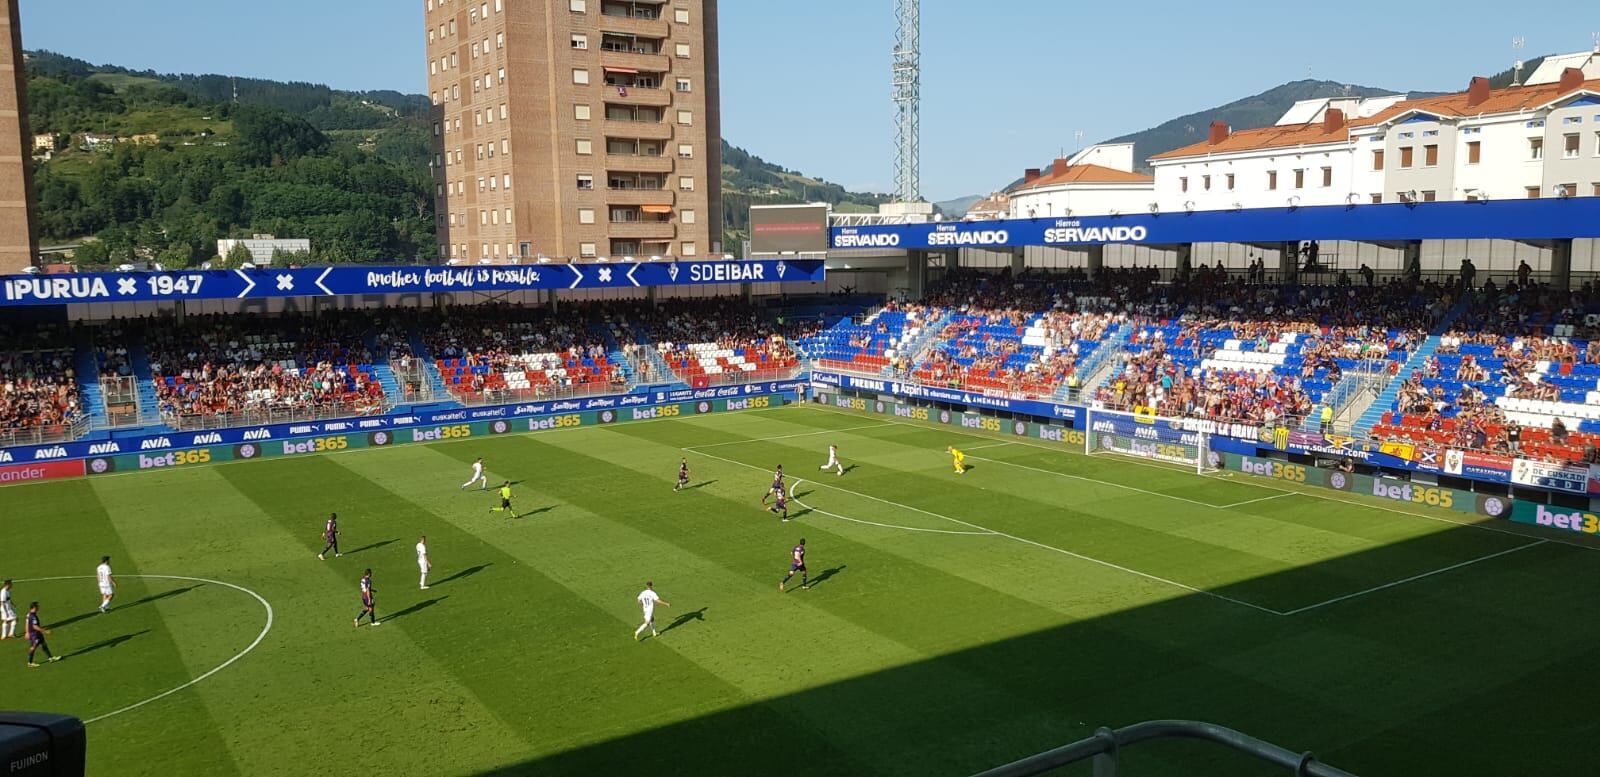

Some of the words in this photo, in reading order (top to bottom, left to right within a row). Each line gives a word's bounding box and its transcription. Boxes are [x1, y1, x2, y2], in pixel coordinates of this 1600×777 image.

[1055, 219, 1080, 228] Hierros
[834, 234, 900, 247] SERVANDO
[927, 230, 1008, 245] SERVANDO
[1044, 226, 1147, 243] SERVANDO
[424, 268, 475, 287] football
[477, 269, 490, 282] is
[5, 277, 109, 300] IPURUA
[147, 275, 203, 295] 1947
[726, 396, 769, 410] bet365
[836, 395, 865, 410] bet365
[894, 403, 928, 420] bet365
[632, 405, 679, 420] bet365
[528, 414, 580, 430] bet365
[961, 413, 1001, 431] bet365
[413, 424, 470, 442] bet365
[1039, 424, 1085, 445] bet365
[283, 436, 348, 454] bet365
[1131, 439, 1185, 458] bet365
[139, 448, 210, 469] bet365
[1241, 456, 1306, 481] bet365
[1547, 469, 1586, 481] EUSKADI
[1373, 478, 1453, 508] bet365
[1536, 504, 1600, 534] bet3
[10, 751, 48, 773] FUJINON
